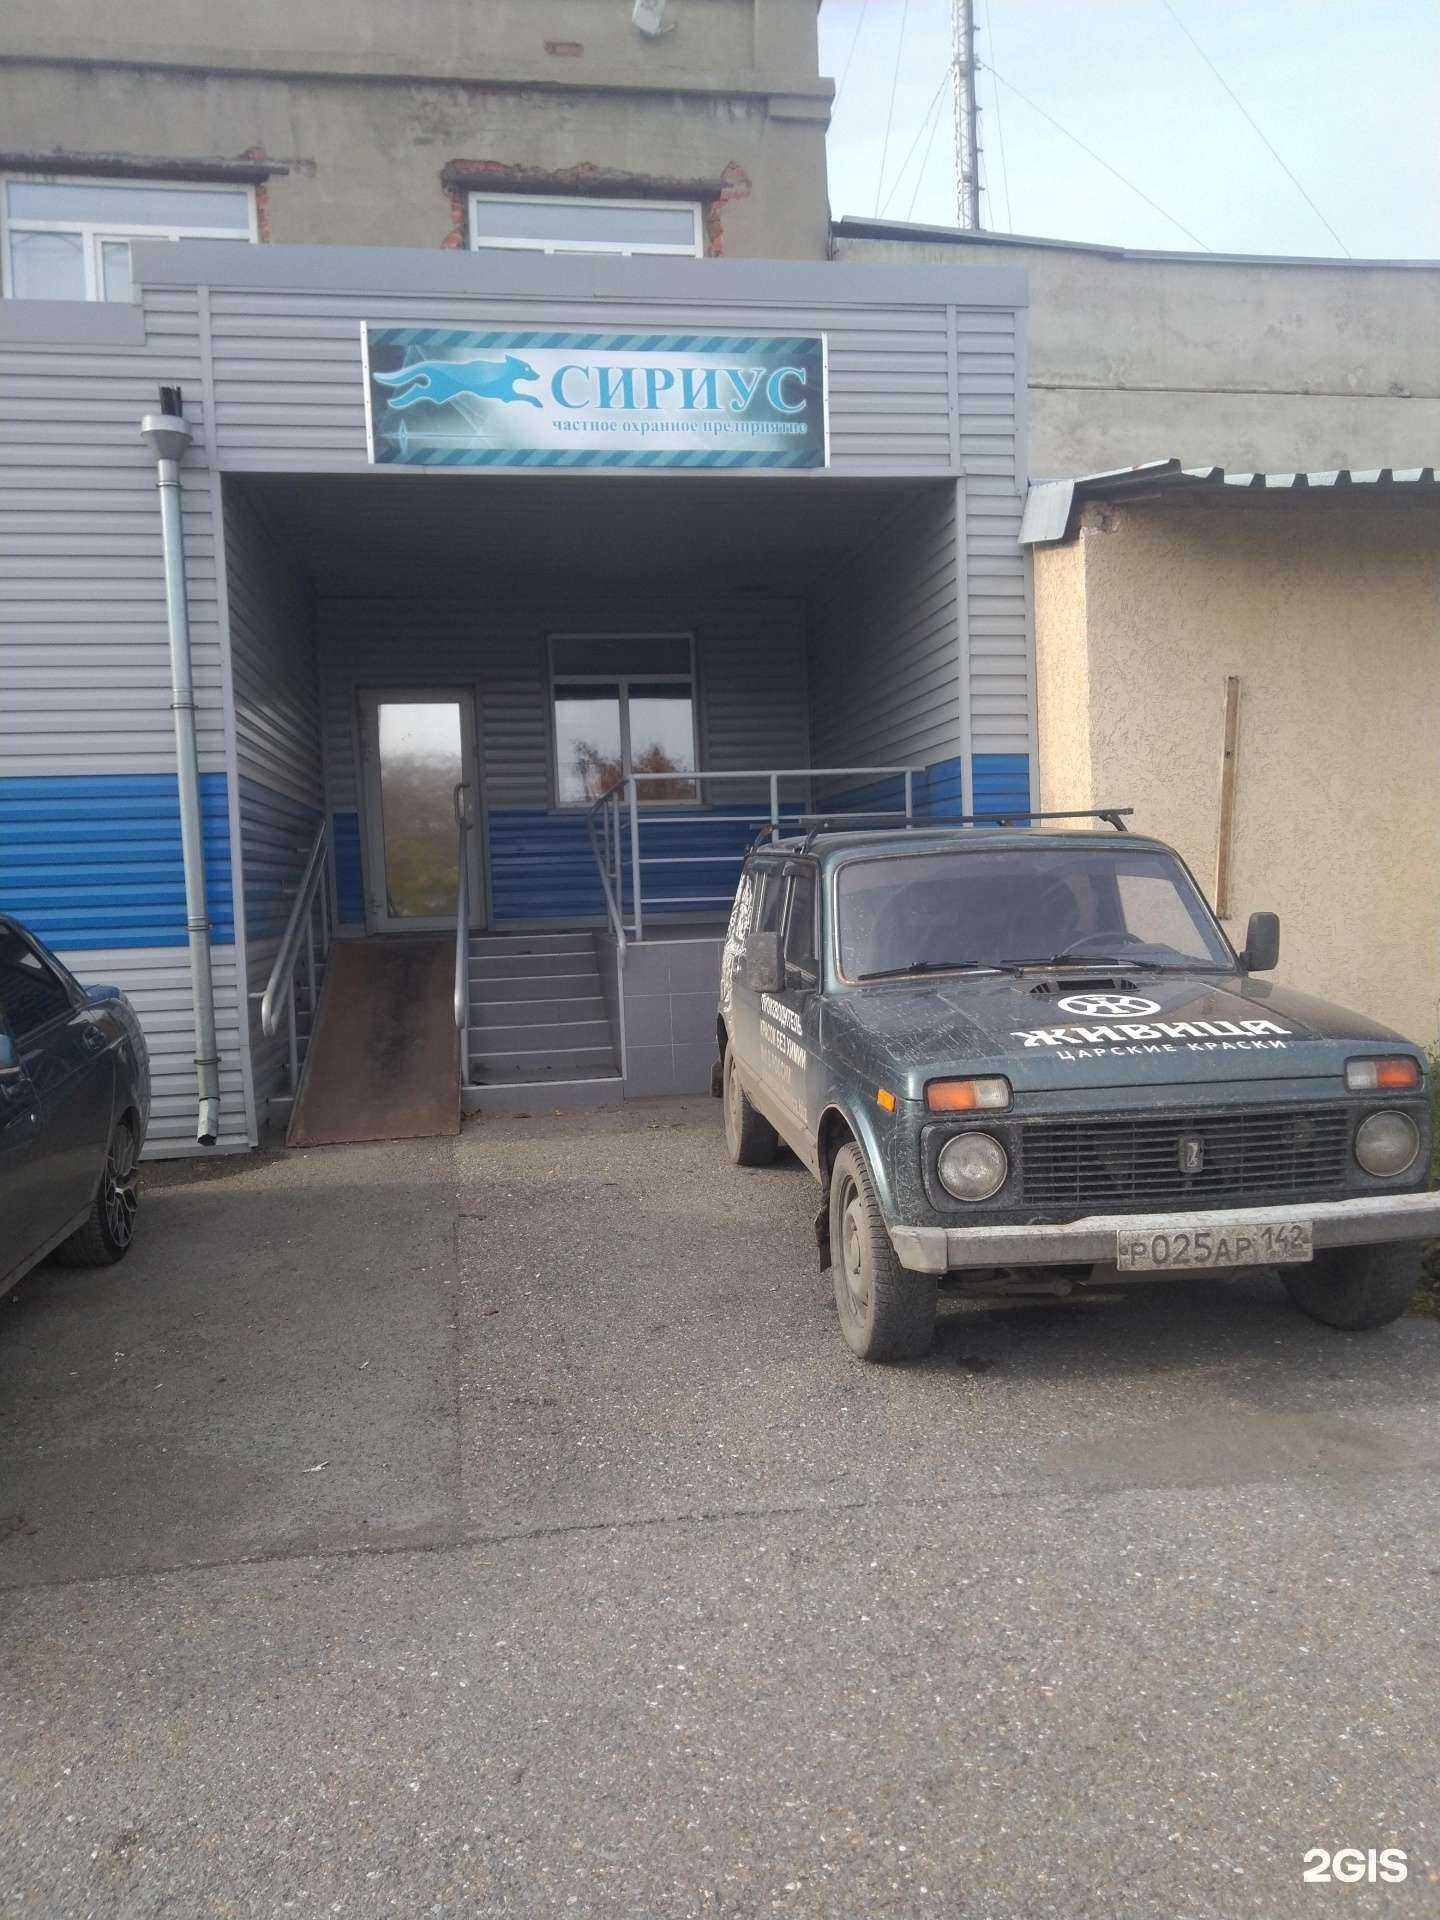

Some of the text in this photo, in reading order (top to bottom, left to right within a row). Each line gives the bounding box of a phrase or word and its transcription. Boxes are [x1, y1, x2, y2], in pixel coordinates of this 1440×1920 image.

[550, 364, 807, 413] СИРИУС
[552, 420, 808, 436] частное охранное предприятие
[1010, 1020, 1292, 1047] ЖИВИЦА
[1056, 1039, 1287, 1062] ЦАРСКИЕ КРАСКИ
